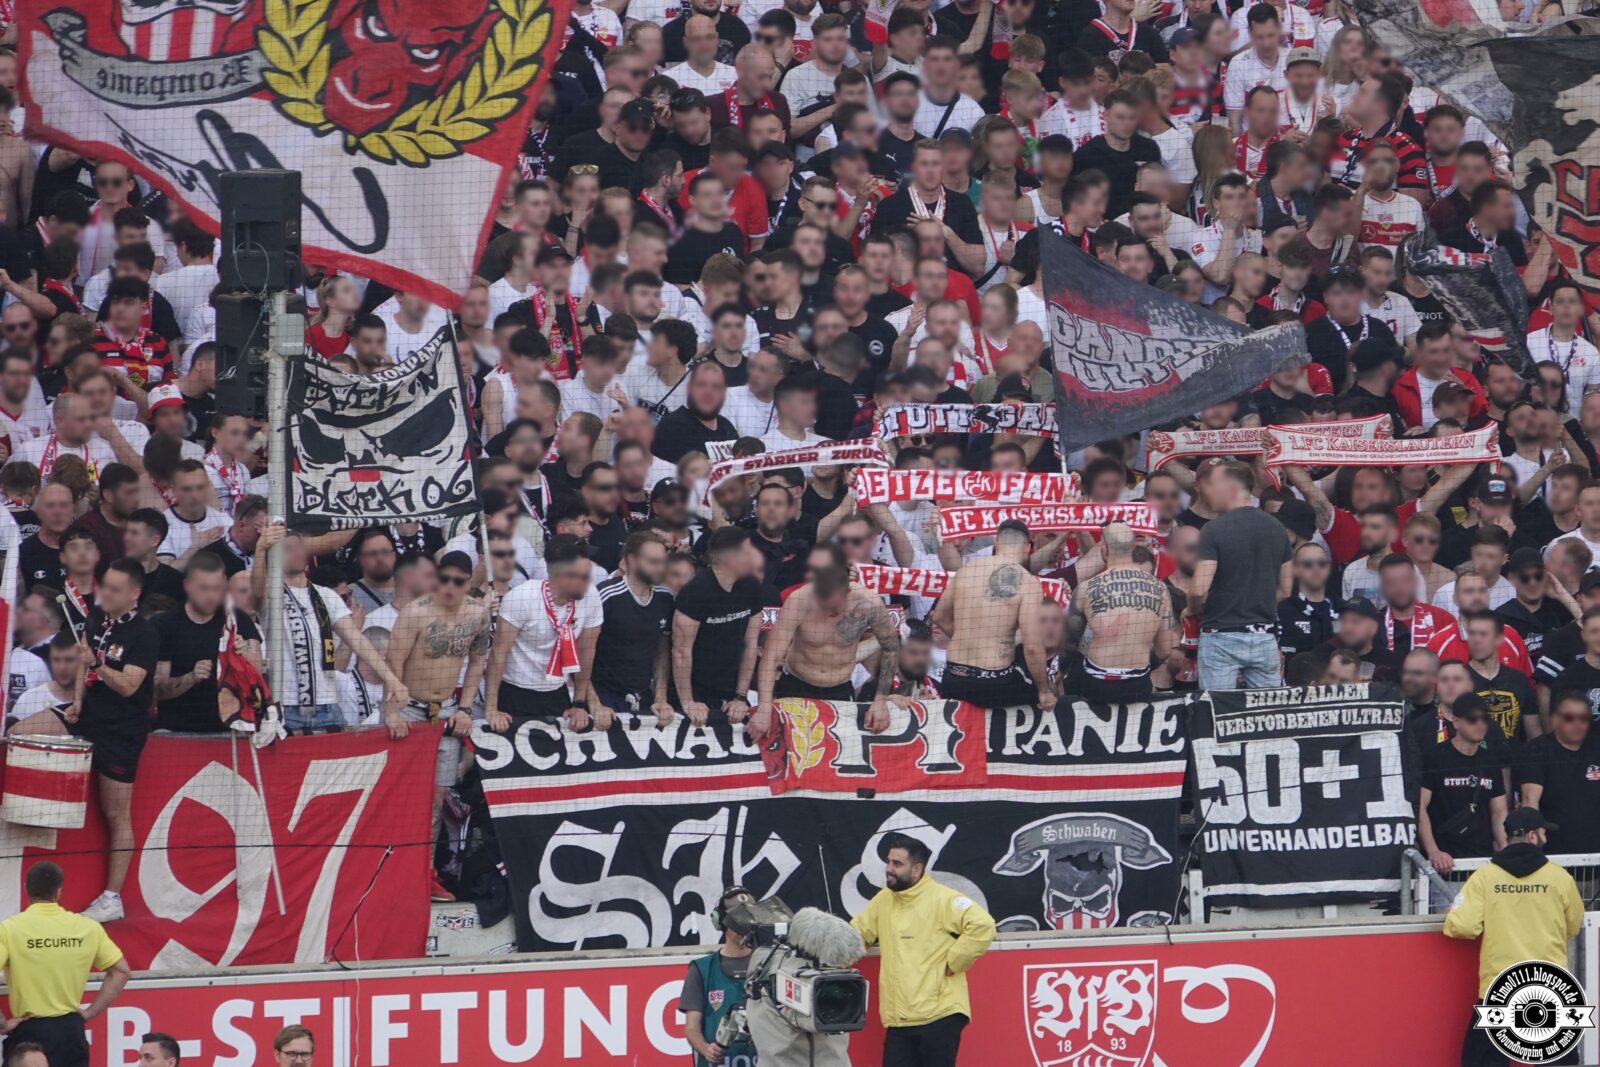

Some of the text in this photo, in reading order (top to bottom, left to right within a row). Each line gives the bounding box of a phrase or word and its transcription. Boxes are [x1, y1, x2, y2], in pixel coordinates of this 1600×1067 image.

[1326, 434, 1476, 452] KAISERSLAUTERN
[743, 451, 820, 471] STÄRKER
[1245, 682, 1370, 708] EHRE ALLEN
[1216, 707, 1403, 737] VERSTORBENEN ULTRAS
[1192, 732, 1416, 825] 50+1
[1041, 823, 1117, 843] Schwaben
[1494, 884, 1549, 895] SECURITY
[26, 937, 84, 949] SECURITY
[79, 980, 693, 1067] B-STIFTUNG
[1056, 1037, 1127, 1053] 18 93
